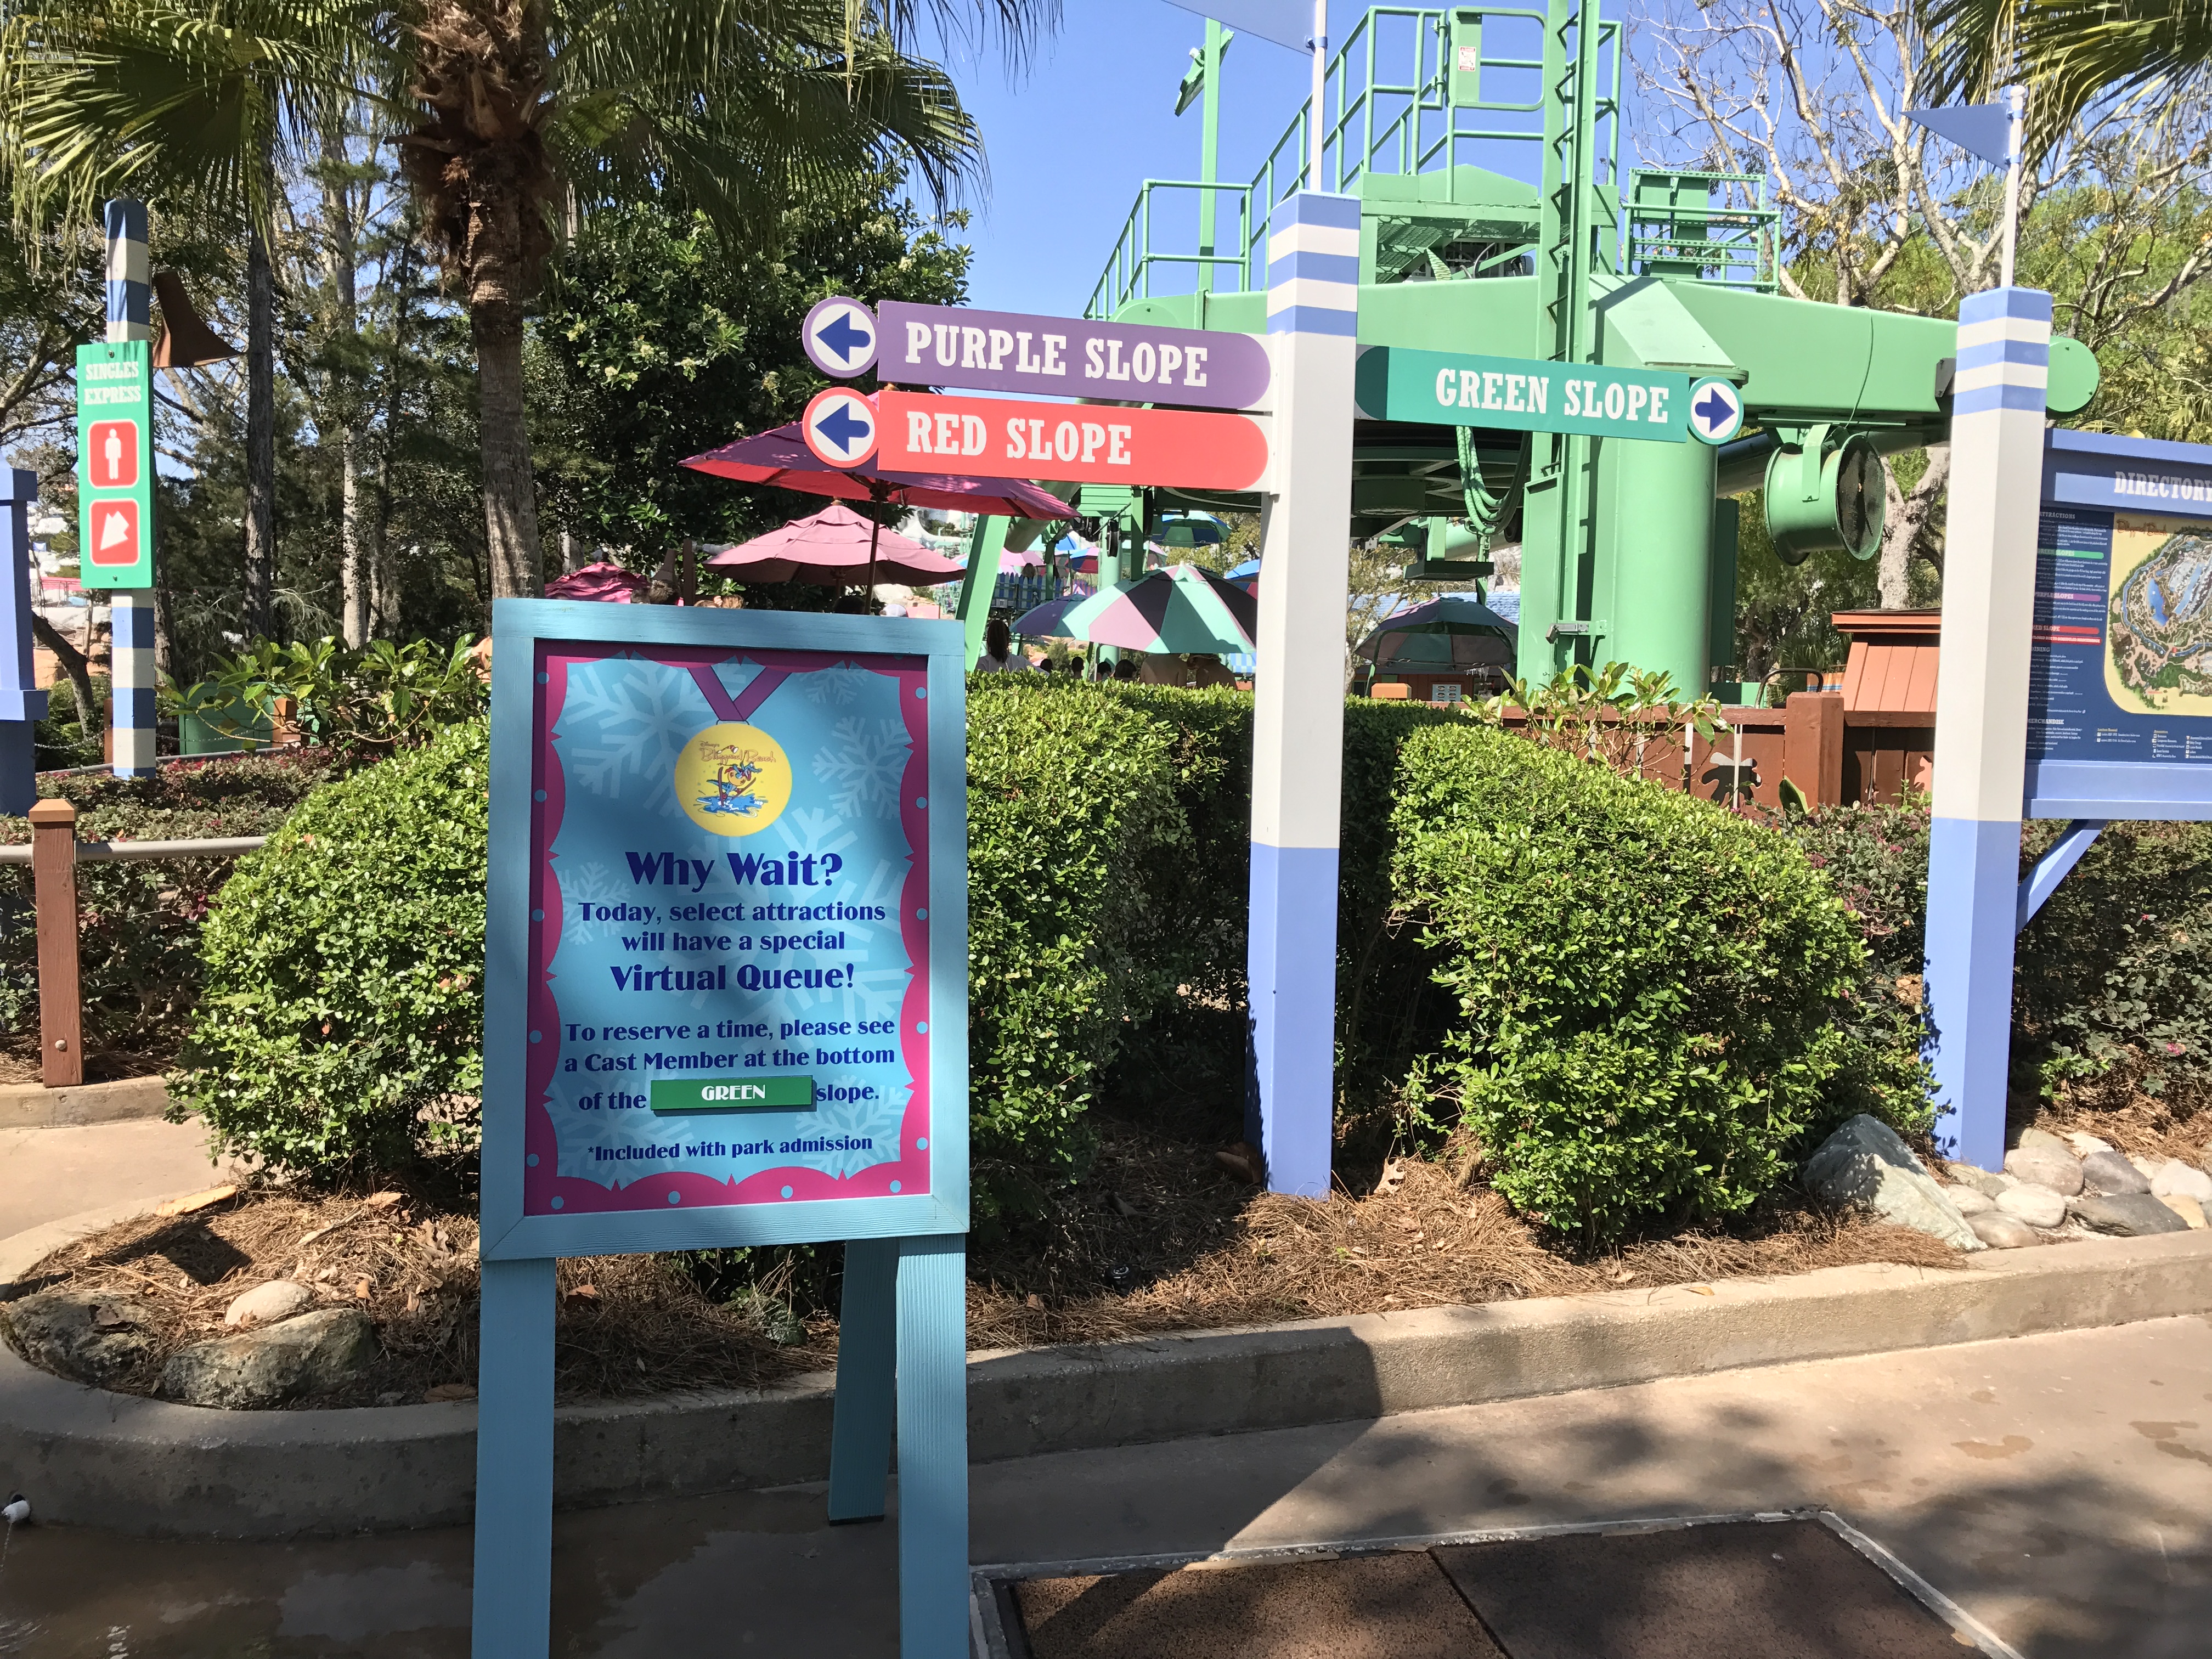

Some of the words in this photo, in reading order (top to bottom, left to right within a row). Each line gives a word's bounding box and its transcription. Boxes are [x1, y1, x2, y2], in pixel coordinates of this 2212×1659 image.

[905, 321, 1066, 376] PURPLE
[1085, 338, 1207, 387] SLOPE
[86, 361, 139, 381] SINGLES
[84, 385, 142, 405] EXPRESS
[1436, 368, 1549, 414] GREEN
[1564, 379, 1669, 424] SLOPE
[906, 411, 987, 456] RED
[1007, 417, 1132, 465] SLOPE
[624, 851, 715, 893] Why
[726, 852, 843, 887] Wait?
[578, 902, 662, 925] Today,
[669, 902, 746, 922] select
[752, 901, 886, 921] attractions
[621, 931, 665, 951] will
[673, 931, 732, 951] have
[738, 935, 752, 951] a
[759, 930, 845, 954] special
[610, 963, 726, 992] Virtual
[736, 962, 855, 991] Queue!
[565, 1023, 596, 1042] To
[602, 1025, 691, 1041] reserve
[697, 1025, 710, 1039] a
[716, 1019, 774, 1041] time,
[780, 1019, 851, 1040] please
[858, 1019, 895, 1035] see
[564, 1057, 578, 1073] a
[585, 1052, 637, 1072] Cast
[644, 1051, 738, 1070] Member
[744, 1049, 767, 1068] at
[772, 1049, 810, 1066] the
[816, 1046, 895, 1065] bottom
[578, 1092, 605, 1110] of
[608, 1091, 647, 1109] the
[701, 1084, 766, 1101] GREEN
[816, 1082, 880, 1104] slope.
[686, 1141, 726, 1157] with
[732, 1139, 775, 1158] park
[779, 1136, 873, 1153] admission
